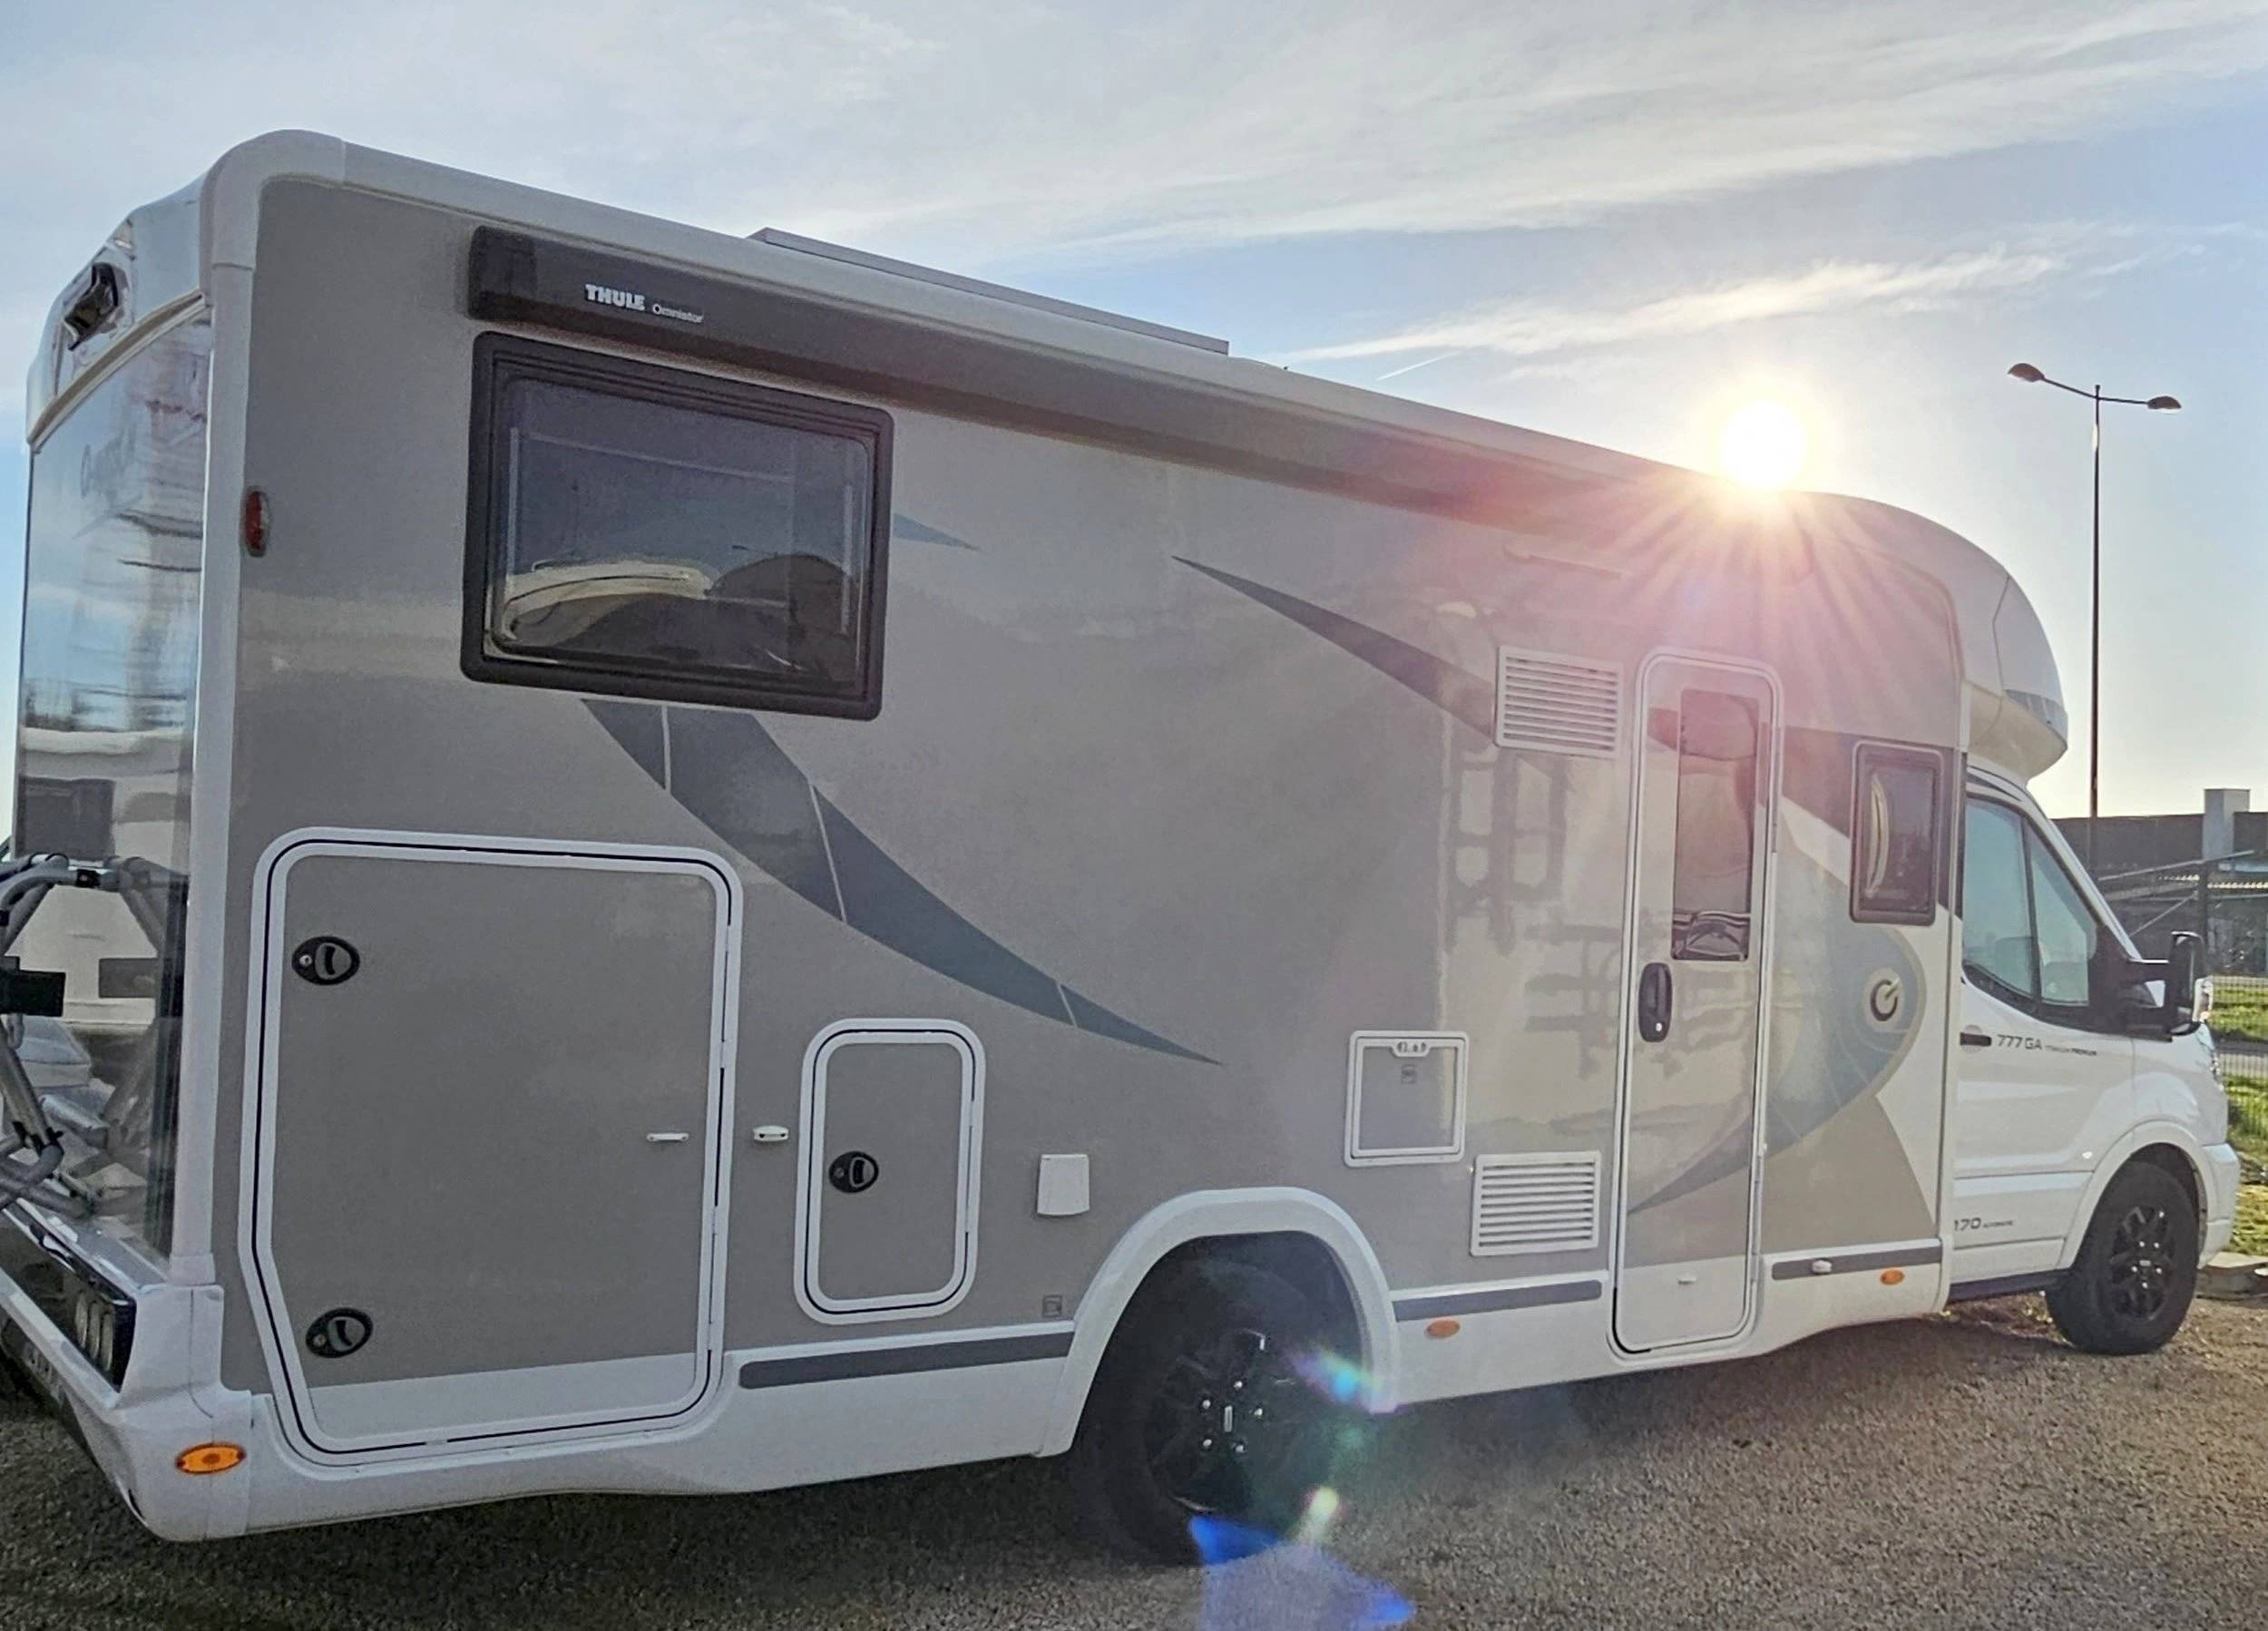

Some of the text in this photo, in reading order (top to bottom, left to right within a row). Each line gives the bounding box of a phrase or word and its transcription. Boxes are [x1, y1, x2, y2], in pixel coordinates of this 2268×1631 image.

[585, 283, 646, 311] THULE
[1998, 1034, 2022, 1048] 777
[1954, 1217, 1981, 1231] 170
